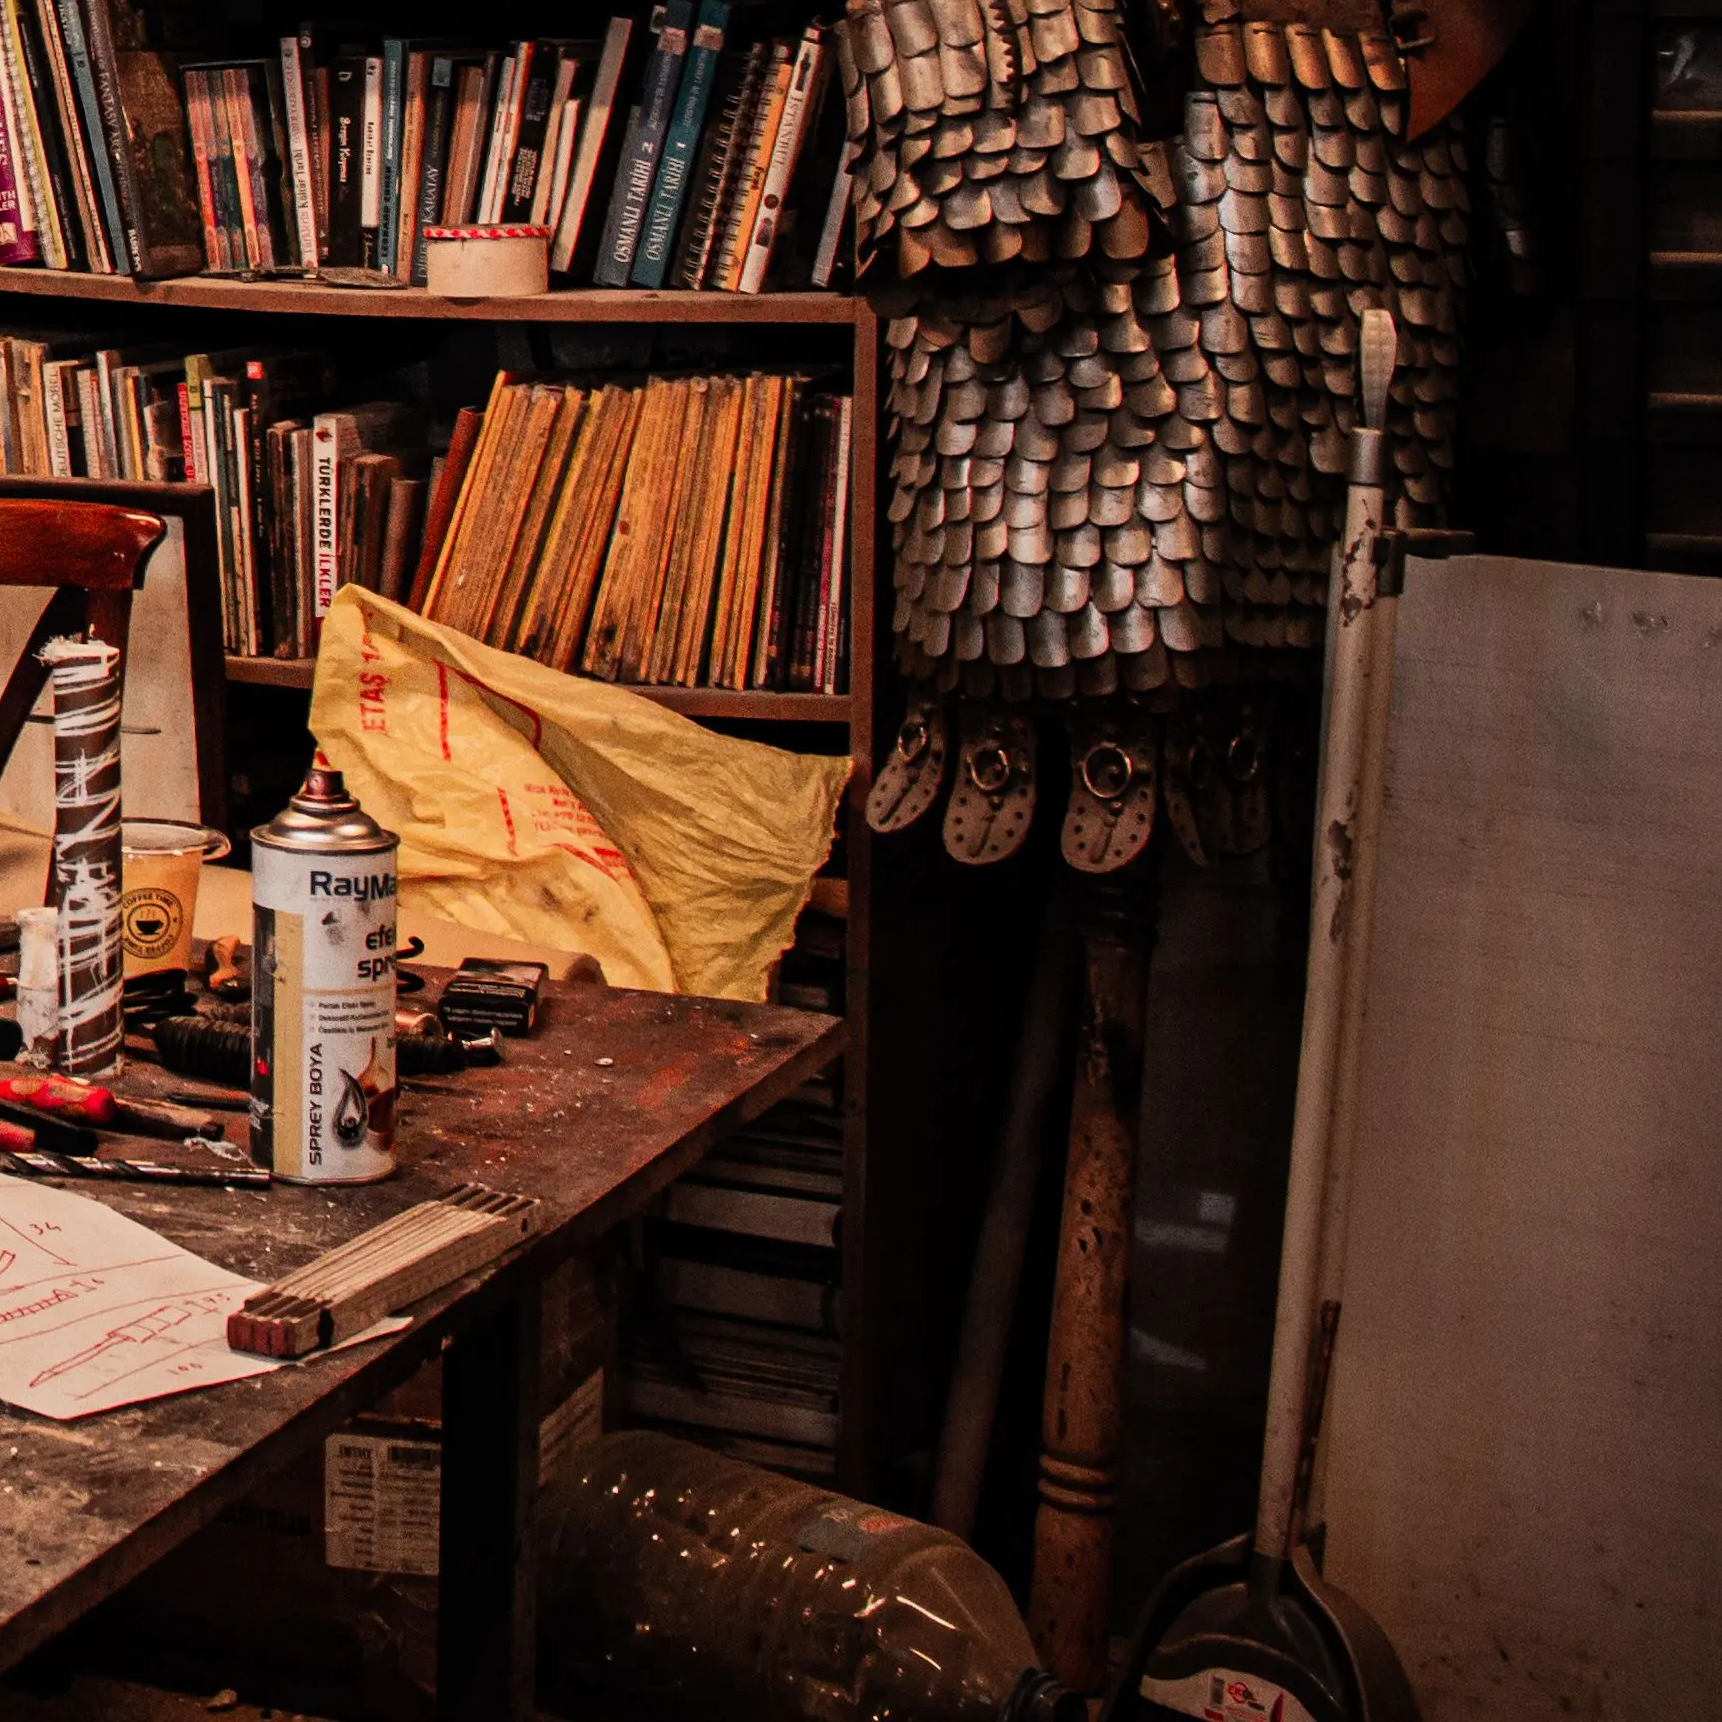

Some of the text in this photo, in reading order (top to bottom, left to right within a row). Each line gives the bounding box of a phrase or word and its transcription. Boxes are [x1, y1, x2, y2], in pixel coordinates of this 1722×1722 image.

[613, 205, 641, 262] OSMANLI
[645, 206, 671, 261] OSMANLI
[318, 457, 333, 607] TÜRKLERDE İLKLER
[309, 870, 396, 901] RayMa
[366, 924, 396, 951] efe
[309, 1043, 322, 1166] SPREY BOYA
